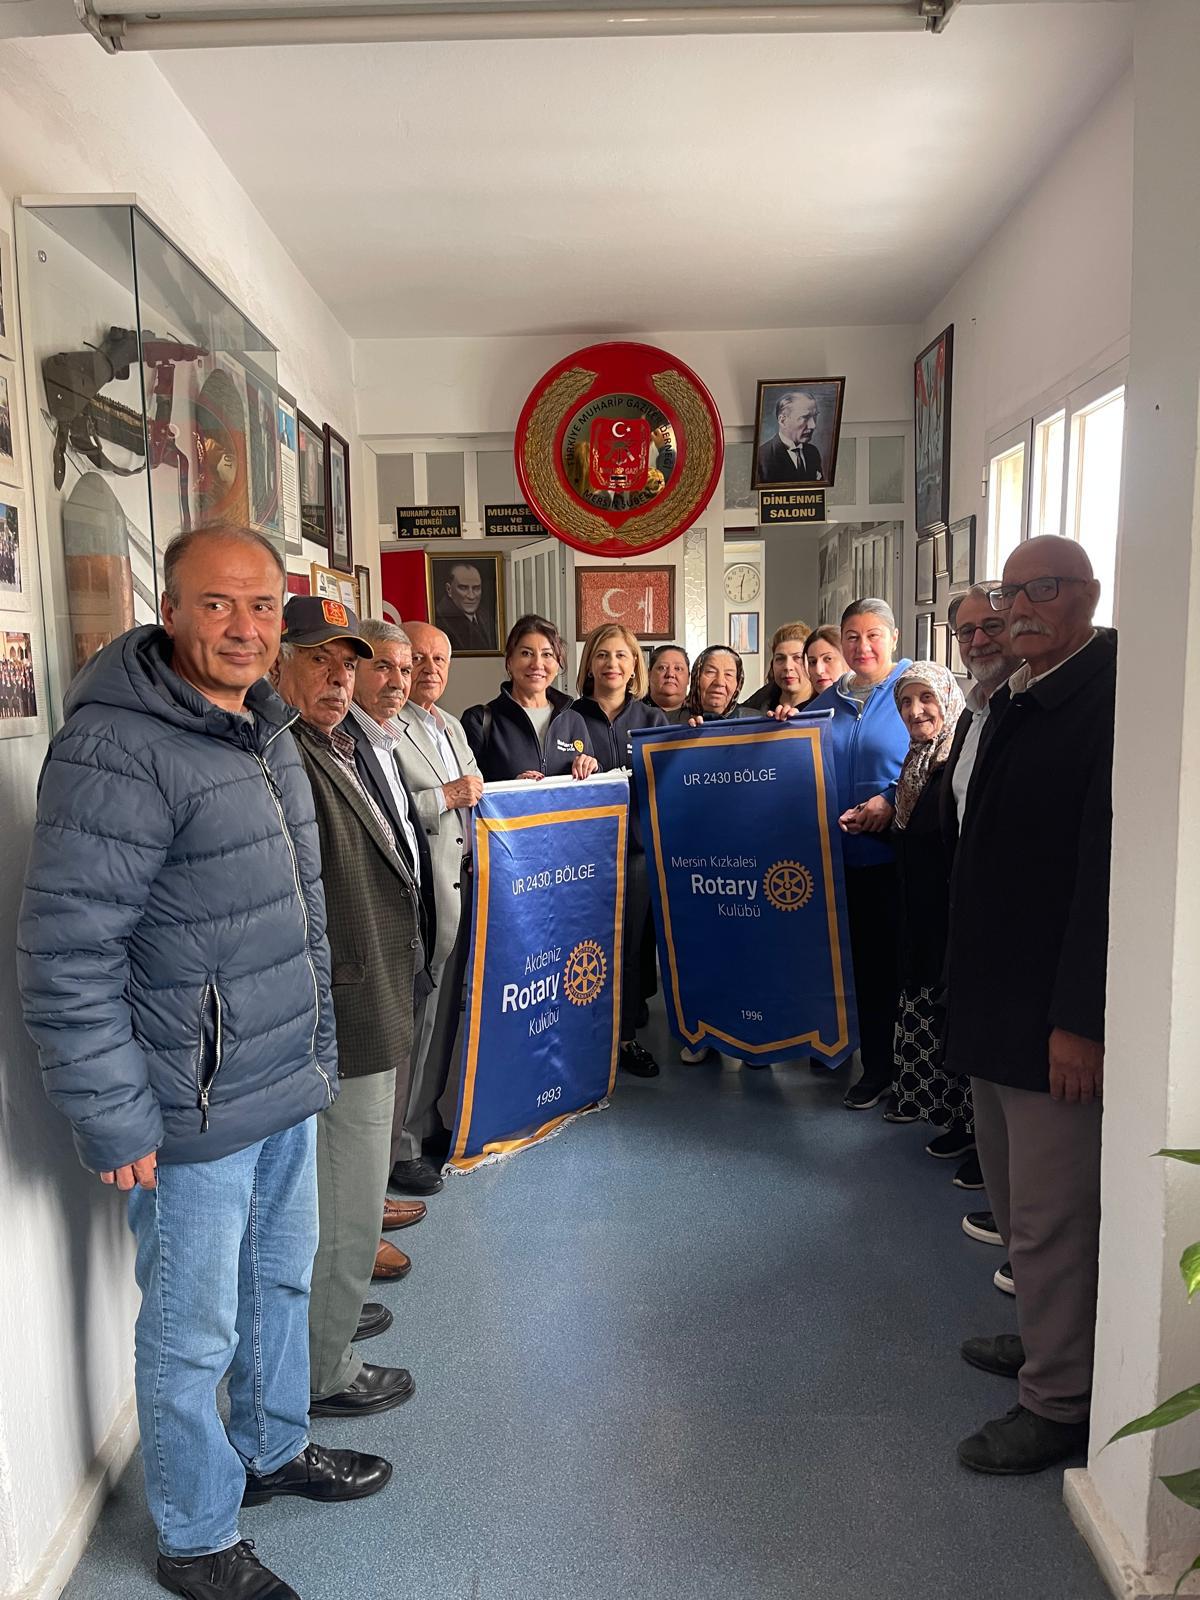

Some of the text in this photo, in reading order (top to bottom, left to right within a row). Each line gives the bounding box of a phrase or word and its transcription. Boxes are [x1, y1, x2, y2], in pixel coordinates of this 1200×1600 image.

[566, 423, 581, 466] TÜRKİYE
[579, 397, 624, 425] MUHARİP
[762, 492, 823, 505] DİNLENME
[400, 508, 457, 518] MUHARİP GAZİLER
[487, 508, 533, 517] MUHASE
[769, 507, 816, 519] SALONU
[415, 516, 443, 526] DERNEĞİ
[510, 516, 523, 524] ve
[400, 527, 458, 537] 2. BAŞKANI
[489, 524, 544, 533] SEKRETER
[683, 767, 777, 786] UR 2430 BÖLGE
[671, 855, 757, 868] Mersin Kızkalesi
[511, 878, 525, 896] UR
[555, 863, 596, 884] BÖLGE
[691, 873, 758, 900] Rotary
[718, 902, 761, 918] Kulübü
[524, 944, 562, 975] Akdeniz
[501, 972, 560, 1013] Rotary
[528, 1006, 560, 1037] Kulübü
[740, 1009, 763, 1022] 1996
[535, 1085, 563, 1109] 1993
